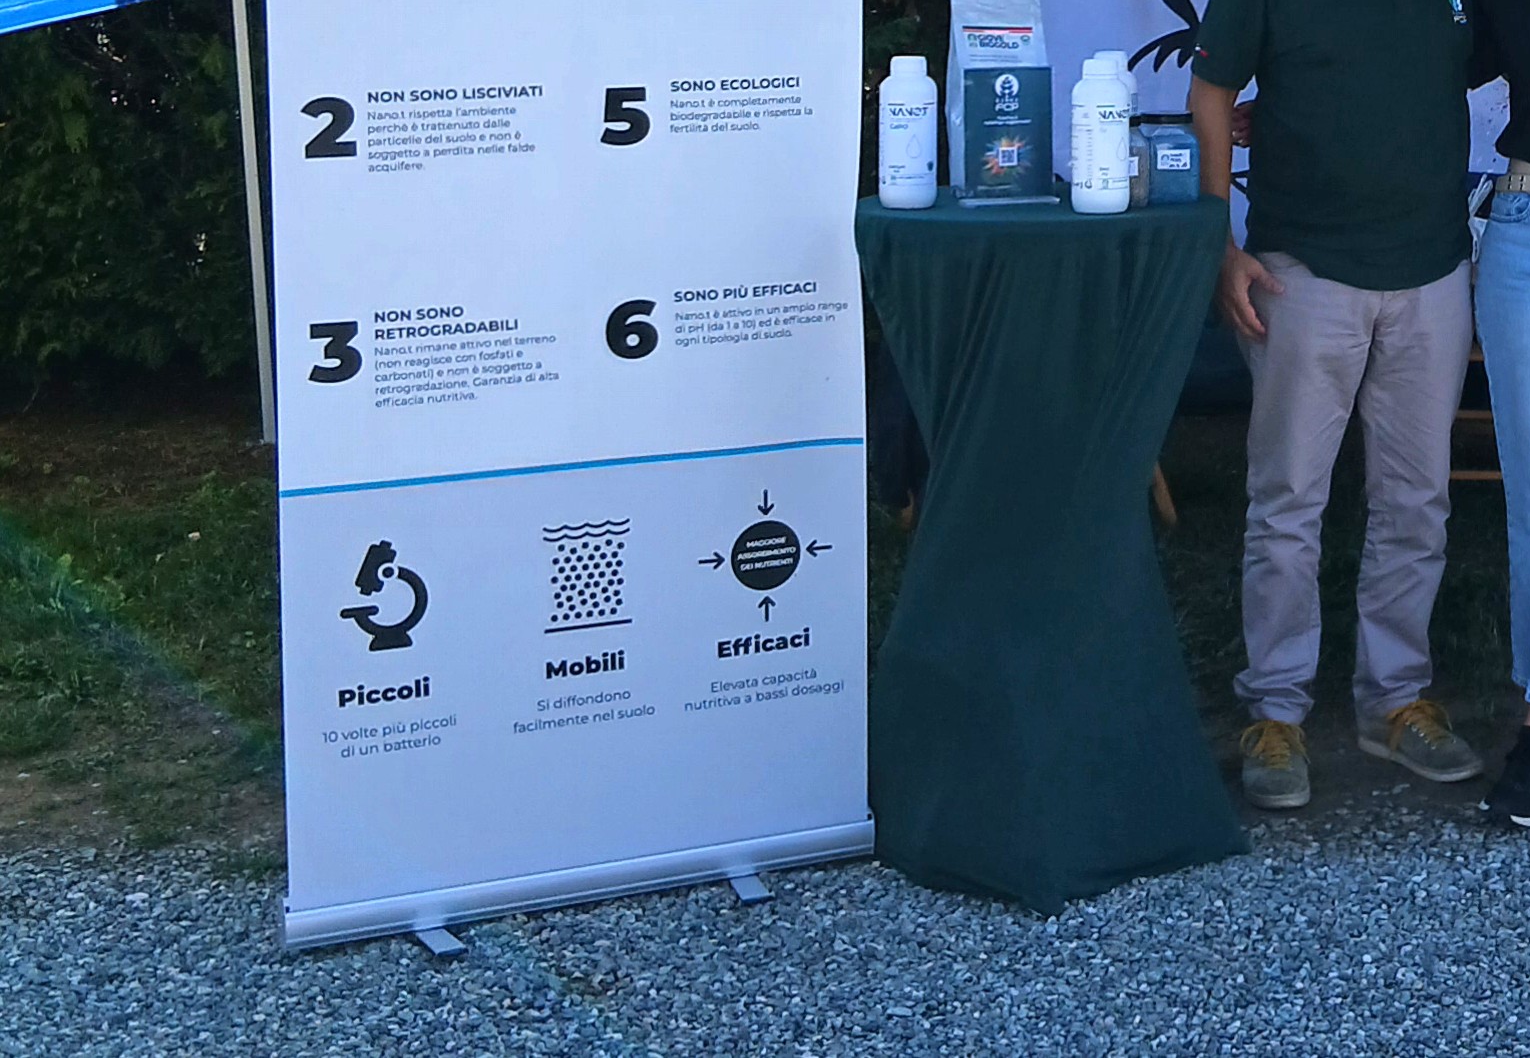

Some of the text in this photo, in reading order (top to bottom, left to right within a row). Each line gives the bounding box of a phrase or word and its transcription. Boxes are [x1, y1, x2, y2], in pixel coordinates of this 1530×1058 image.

[367, 85, 543, 104] NON SONO LISCIVIATI
[669, 76, 800, 92] SONO ECOLOGICI
[407, 107, 453, 122] rispetta
[454, 104, 517, 117] l'ambiente
[600, 86, 651, 146] 5
[299, 97, 357, 159] 2
[673, 281, 817, 303] SONO PIÙ EFFICACI
[374, 305, 464, 323] NON SONO
[374, 318, 519, 341] RETROGRADABILI
[605, 299, 659, 359] 6
[307, 321, 363, 383] 3
[414, 340, 457, 353] rimane
[458, 337, 492, 350] attivo
[493, 336, 513, 347] nel
[513, 332, 557, 346] terreno
[374, 349, 514, 372] (non reagisce con fosfati
[374, 360, 533, 385] carbonati) non soggetto
[471, 373, 523, 387] Garanzia
[537, 370, 560, 382] alta
[375, 393, 425, 407] efficacia
[717, 626, 811, 659] Efficaci
[545, 649, 625, 679] Mobili
[338, 676, 431, 708] Piccoli
[711, 667, 816, 693] Elevata capacità
[537, 689, 631, 711] Si diffondono
[686, 680, 843, 711] nutritiva bassi dosaggi
[323, 714, 456, 743] 10 volte più piccoli
[514, 704, 655, 734] facilmente nel suolo
[341, 734, 440, 757] di un batterio
